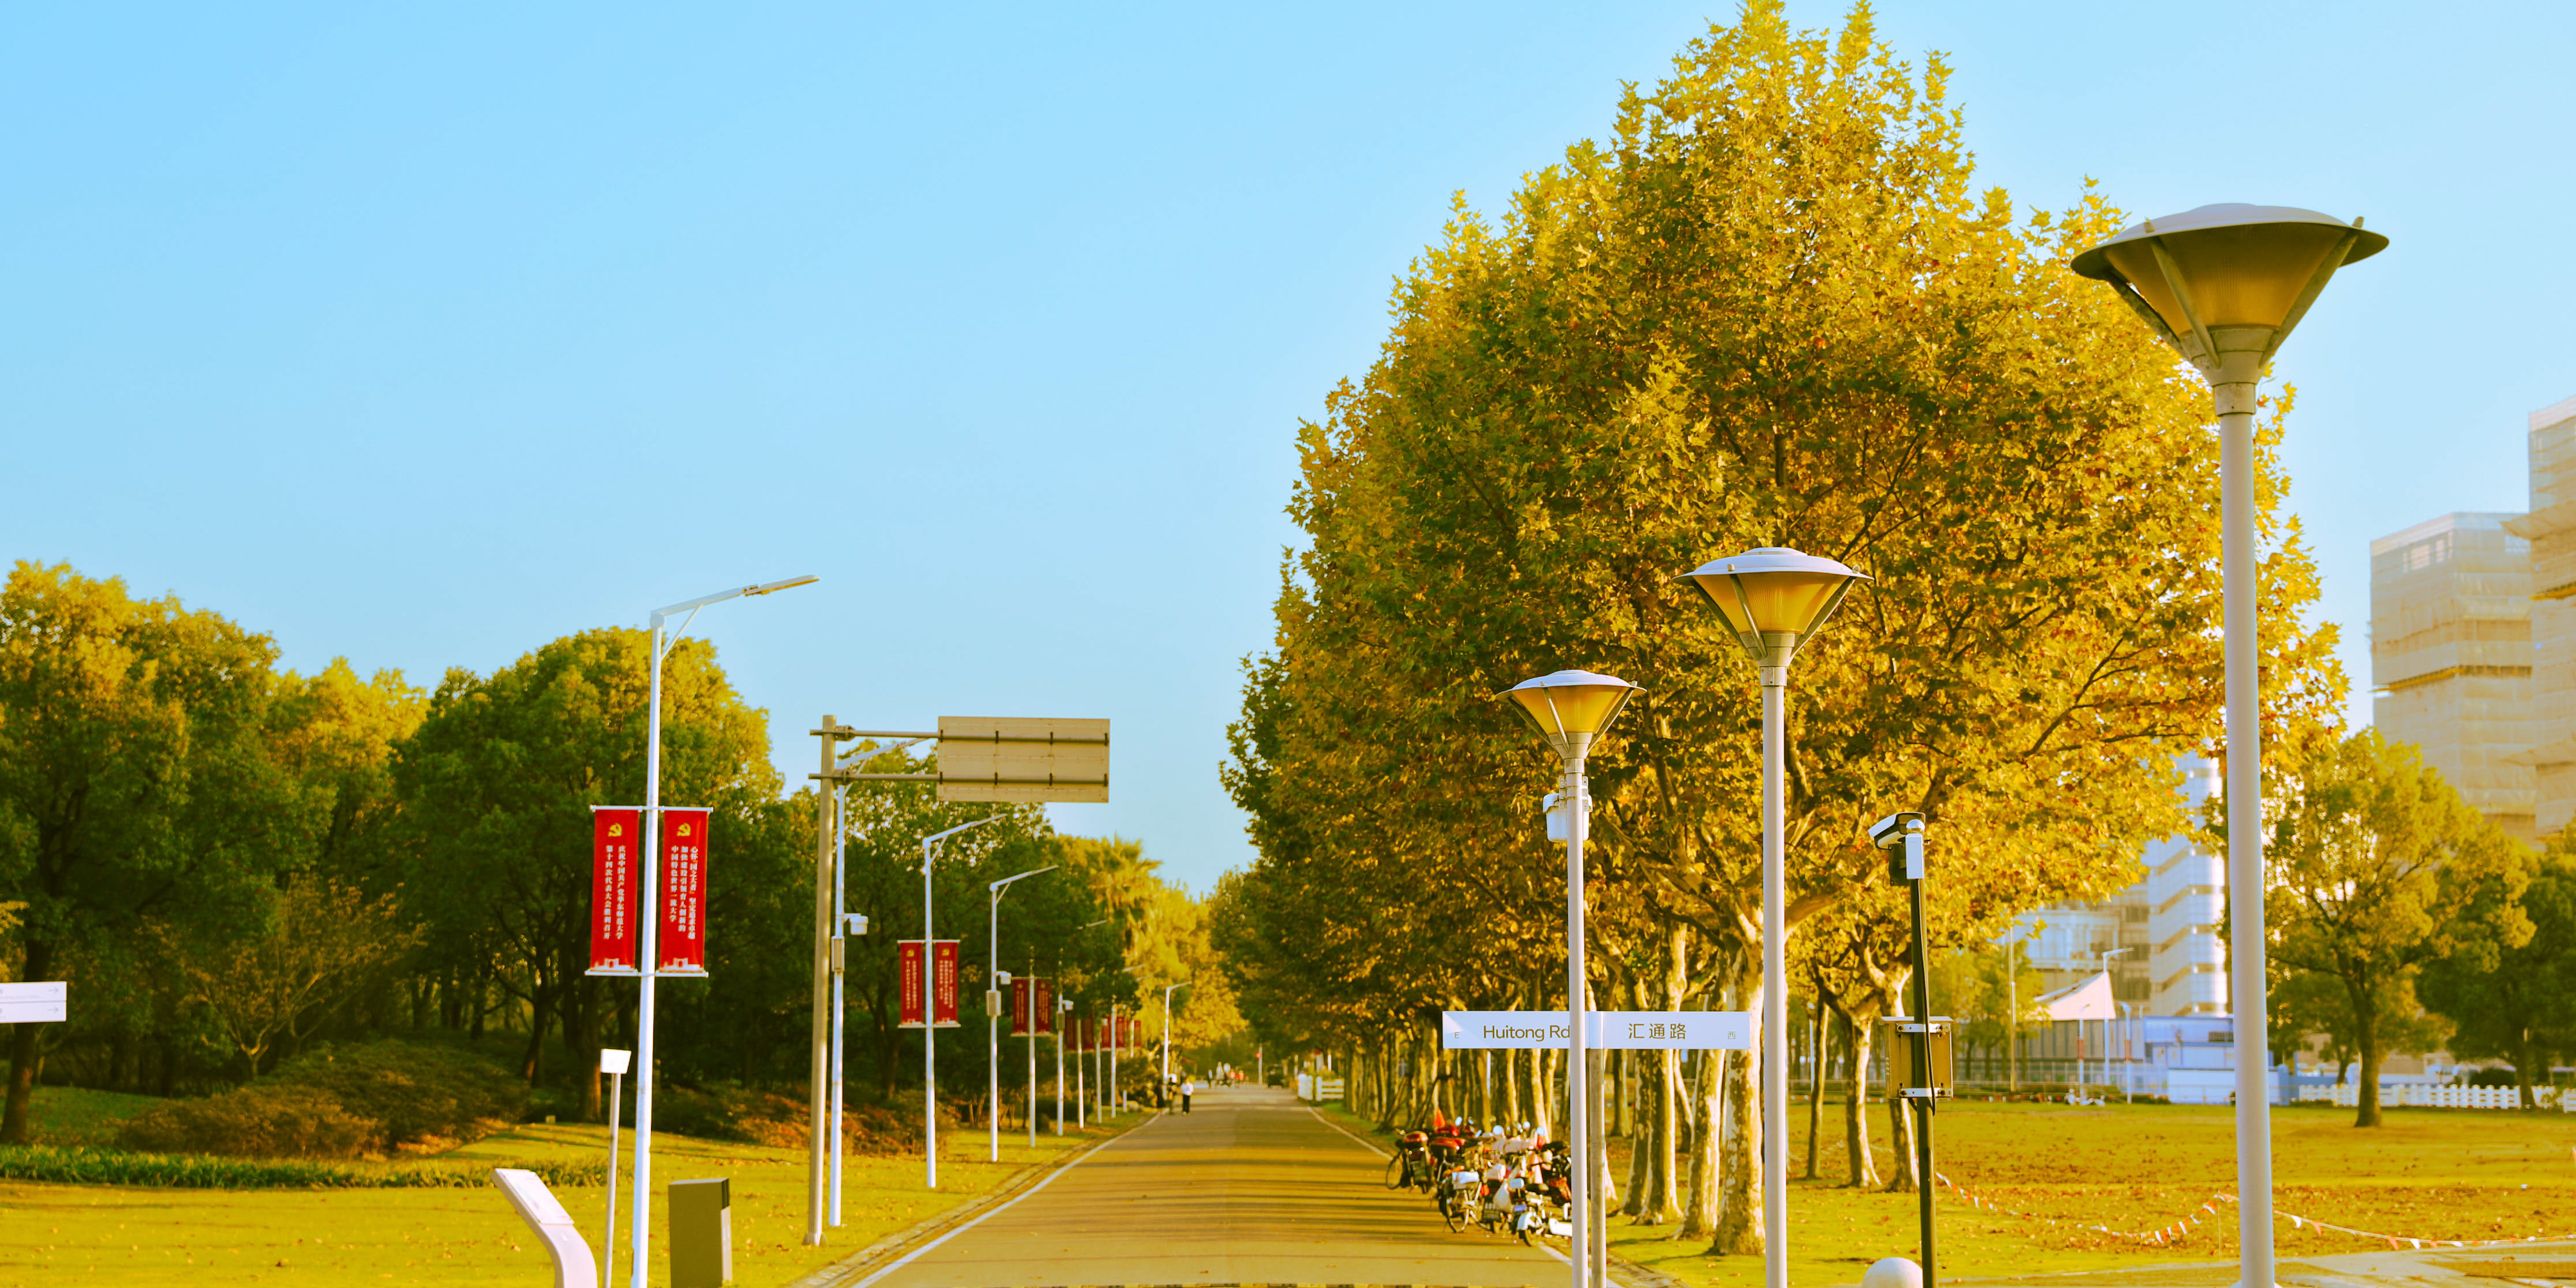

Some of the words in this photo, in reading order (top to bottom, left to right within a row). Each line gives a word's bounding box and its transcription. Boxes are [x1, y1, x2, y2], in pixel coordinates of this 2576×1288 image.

[669, 846, 679, 922] 中国特色世界一流大学
[1483, 1025, 1545, 1042] Huitong
[1549, 1025, 1570, 1039] Rd
[1627, 1022, 1687, 1040] 汇通路
[1727, 1031, 1736, 1040] 西
